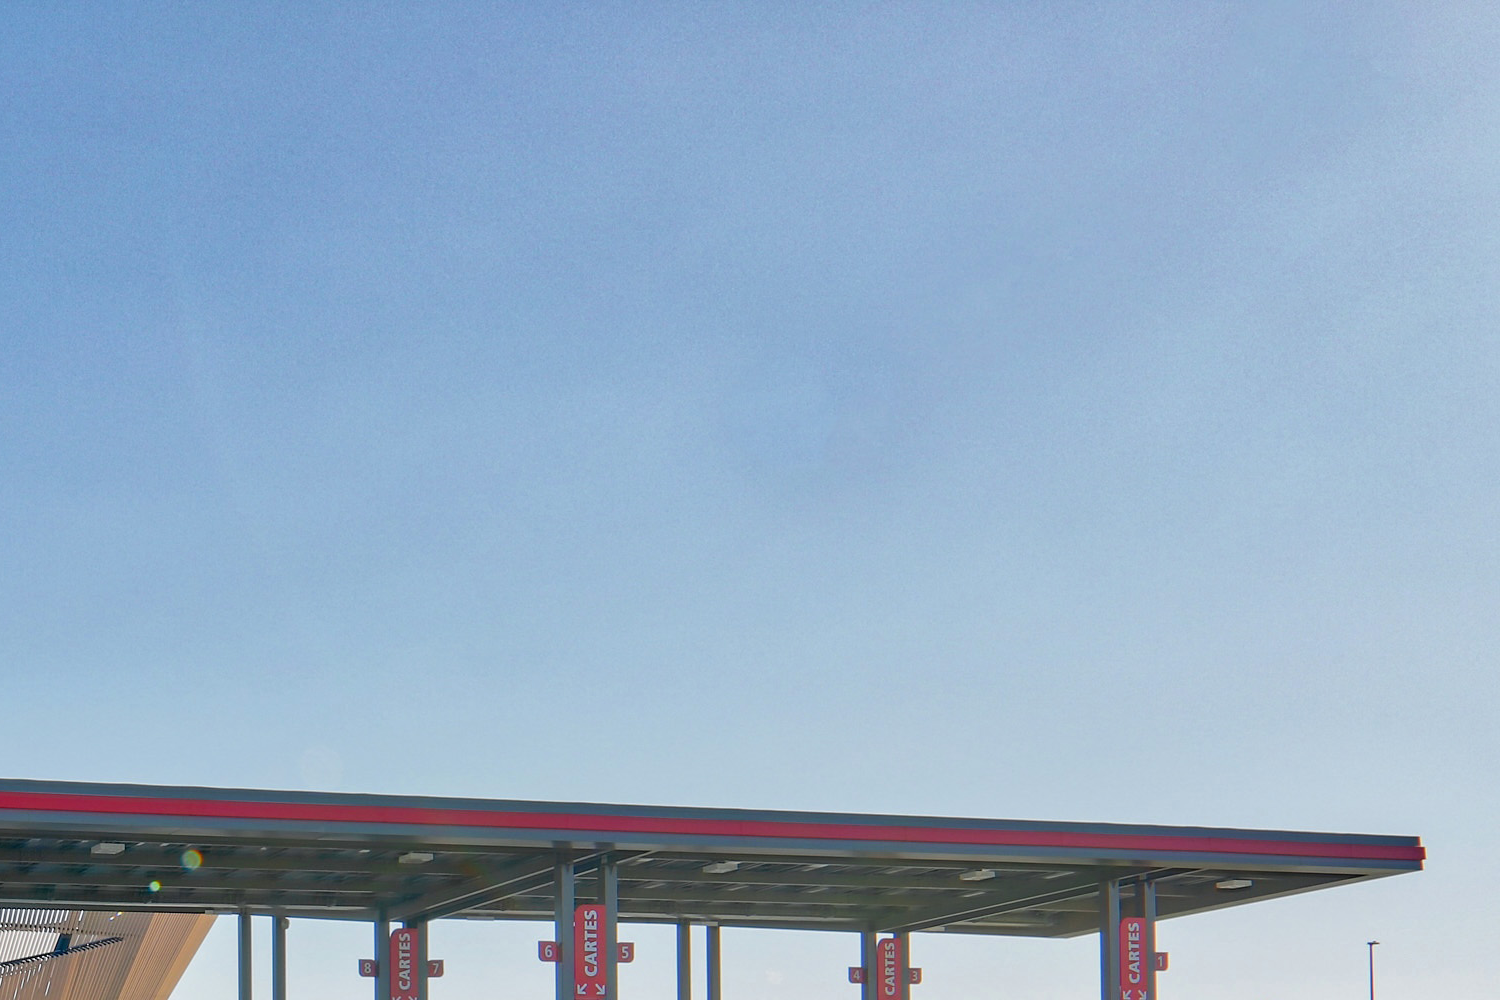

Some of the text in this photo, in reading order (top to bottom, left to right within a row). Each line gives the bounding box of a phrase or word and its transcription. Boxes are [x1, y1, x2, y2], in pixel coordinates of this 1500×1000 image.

[584, 910, 598, 977] CARTES
[544, 945, 553, 958] 6
[621, 946, 629, 959] 5
[1128, 922, 1141, 984] CARTES
[364, 962, 372, 974] 8
[399, 933, 411, 991] CARTES
[1157, 956, 1163, 967] 1
[432, 963, 439, 975] 7
[853, 970, 860, 981] 4
[884, 942, 895, 996] CARTES
[912, 970, 918, 981] 3
